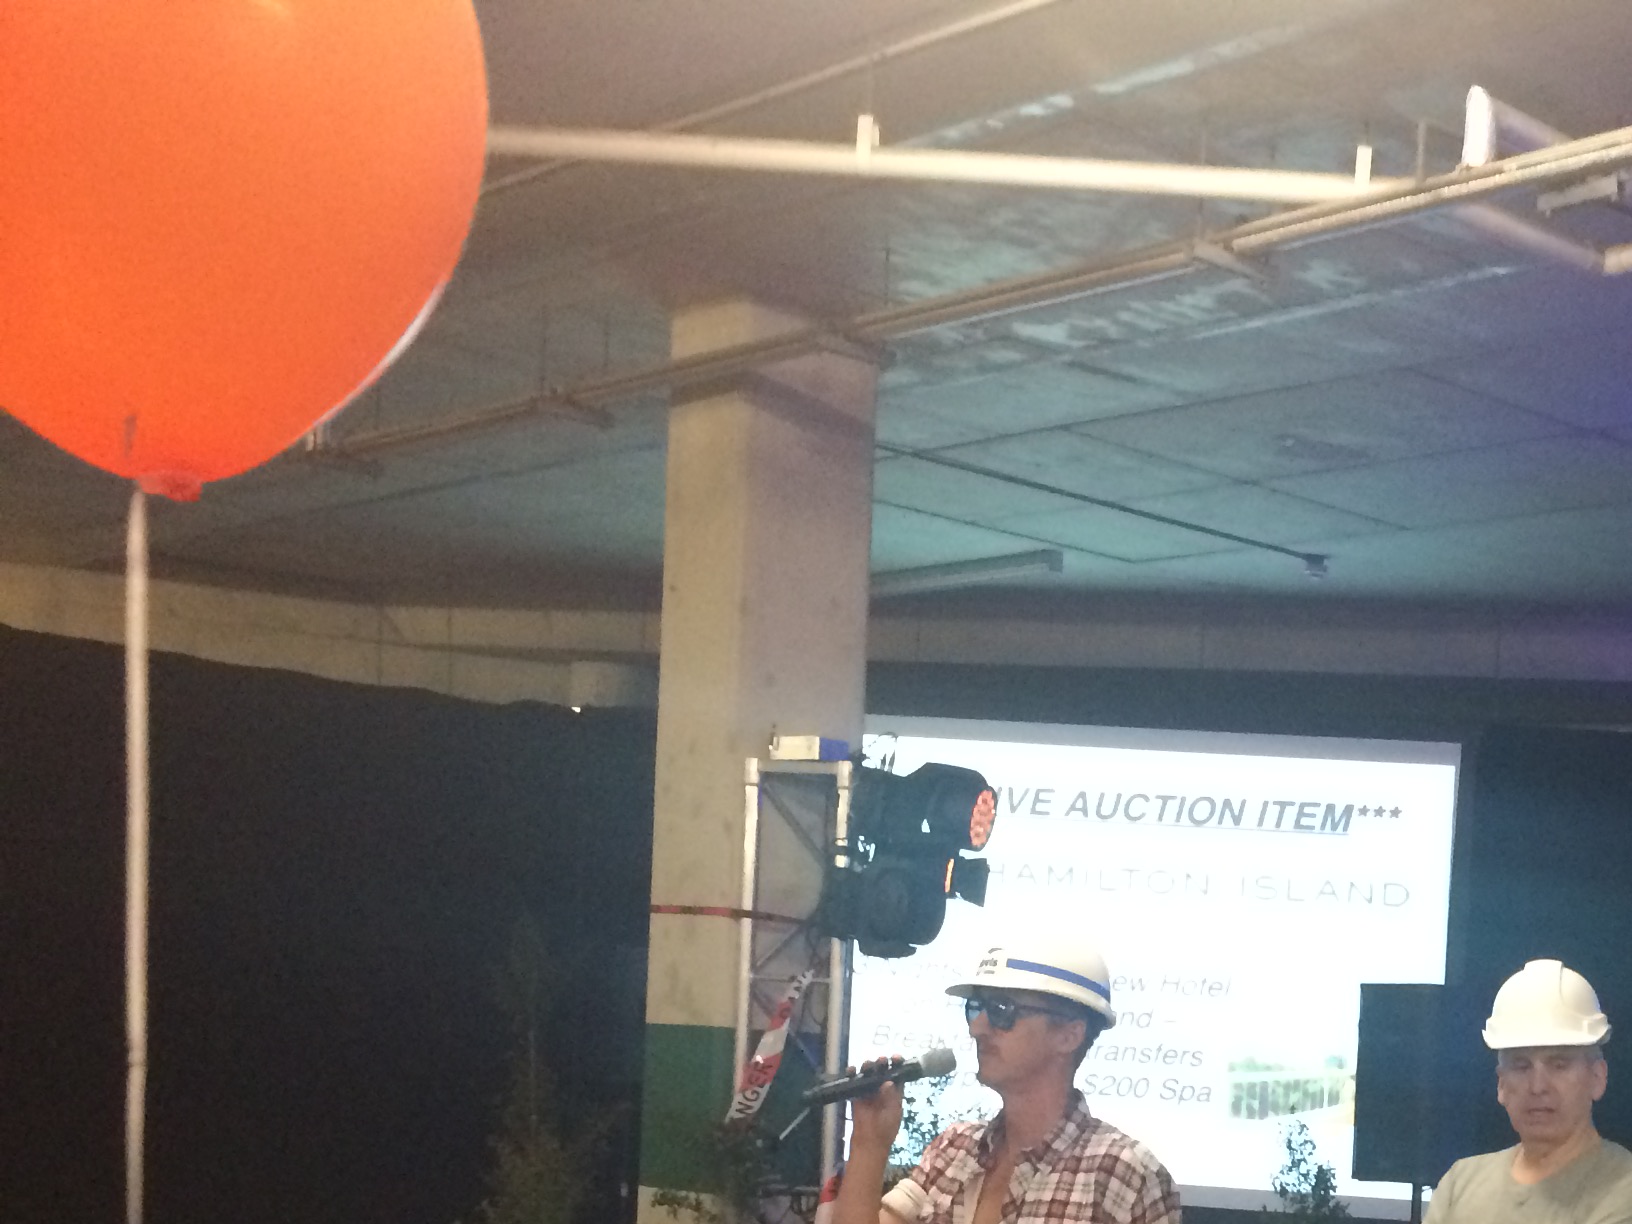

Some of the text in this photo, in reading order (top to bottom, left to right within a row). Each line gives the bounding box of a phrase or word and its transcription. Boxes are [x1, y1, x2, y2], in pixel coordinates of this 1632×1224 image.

[996, 786, 1055, 815] IVE
[1065, 790, 1246, 828] AUCTION
[989, 862, 1411, 908] HAMILTON ISLAND
[1160, 974, 1231, 997] Hotel
[1082, 1073, 1212, 1105] $200 Spa
